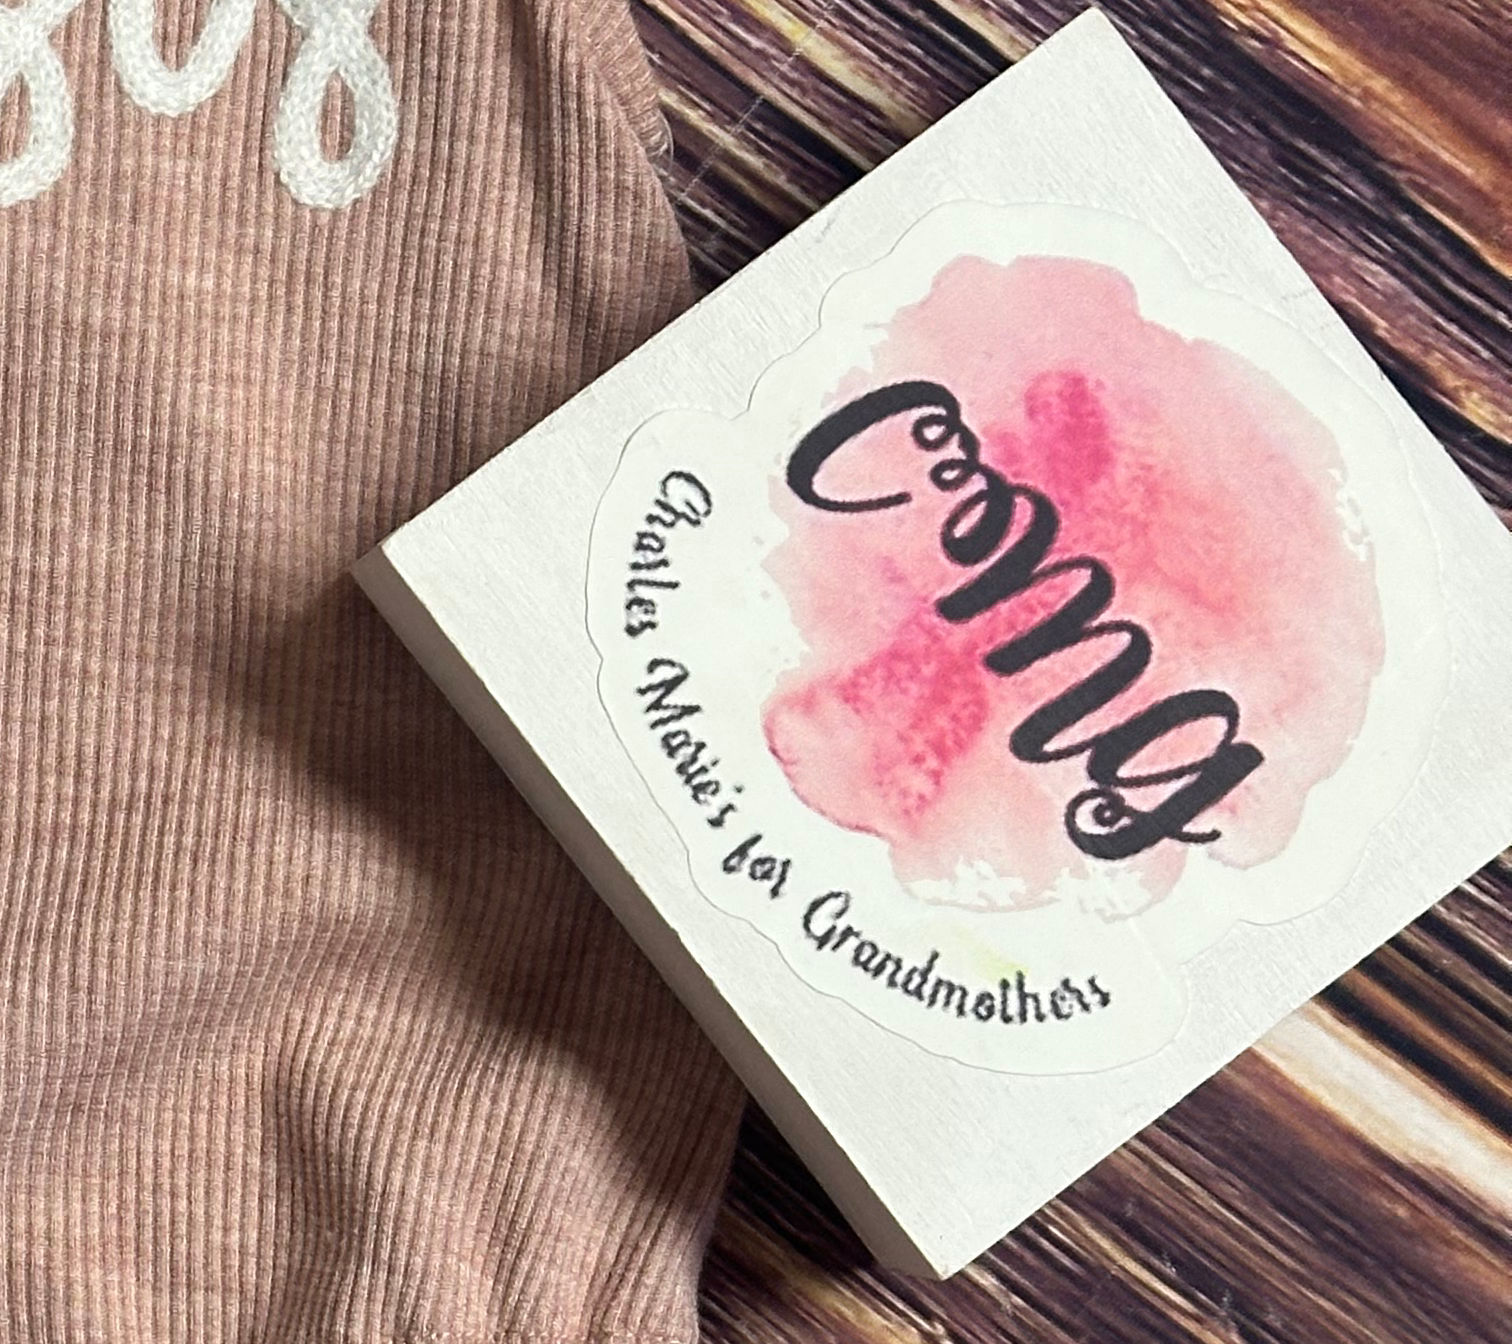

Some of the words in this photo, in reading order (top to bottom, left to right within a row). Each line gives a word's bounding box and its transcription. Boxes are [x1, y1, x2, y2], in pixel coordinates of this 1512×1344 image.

[624, 470, 712, 638] Charles
[636, 658, 745, 828] Marie's
[721, 834, 792, 899] for
[802, 891, 1111, 1025] Grandmothers
